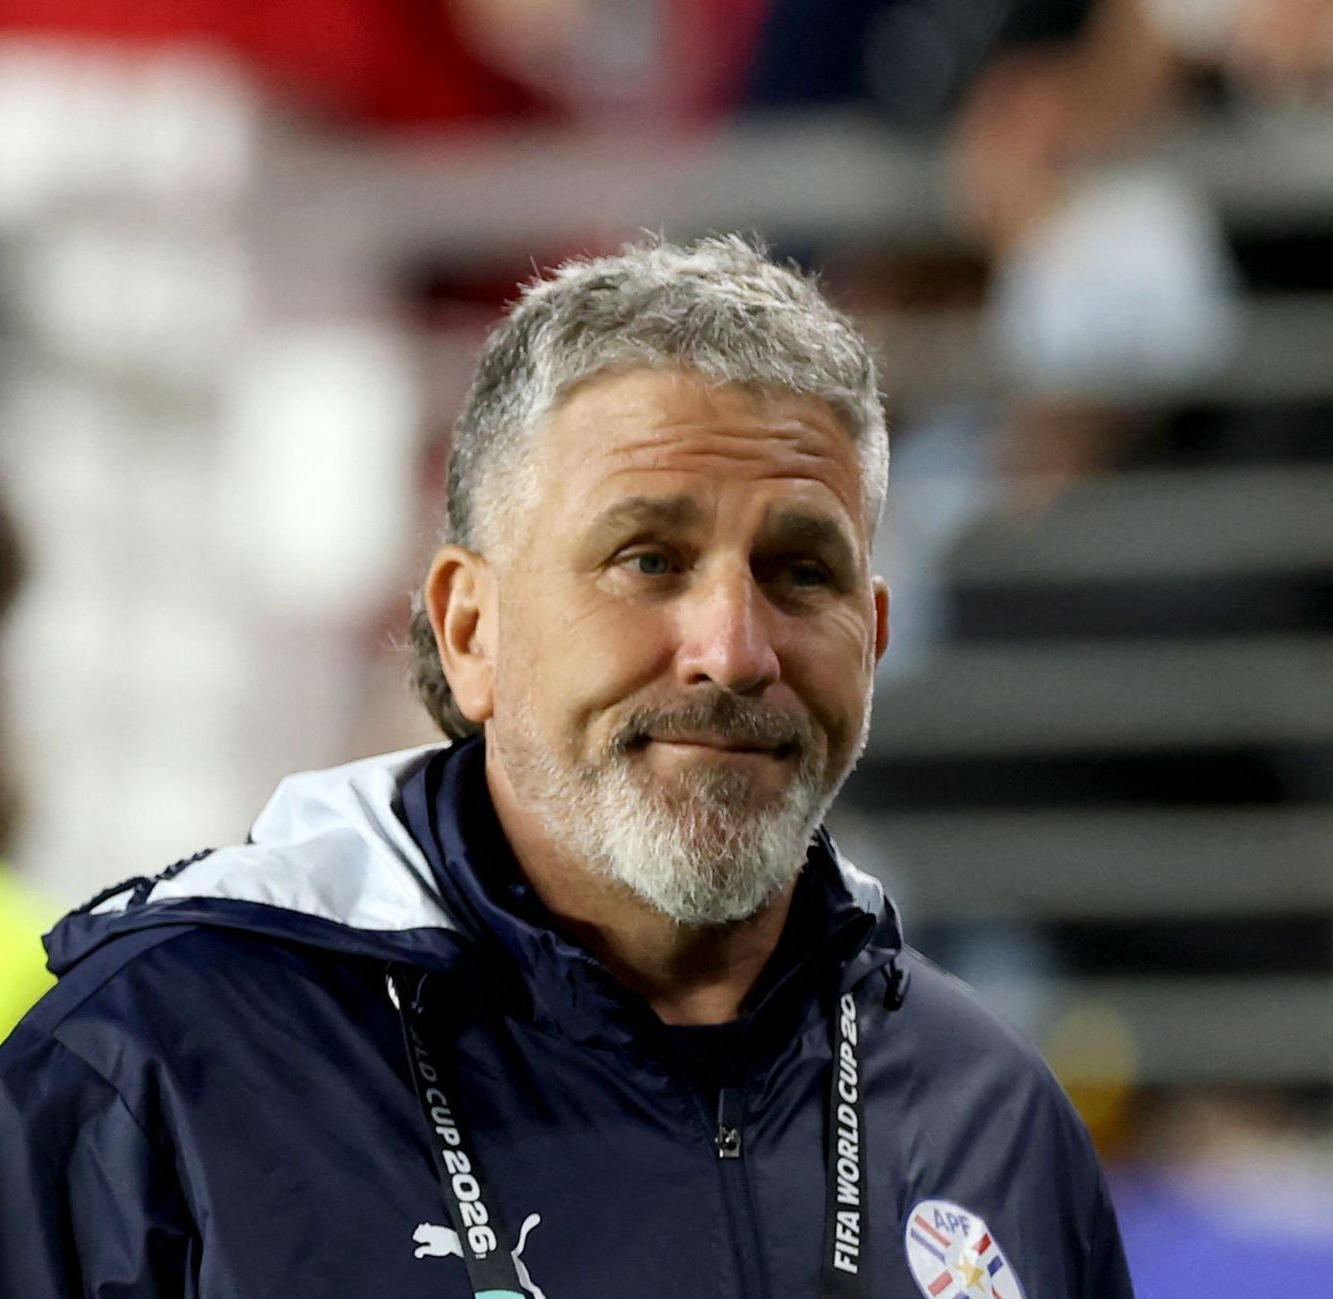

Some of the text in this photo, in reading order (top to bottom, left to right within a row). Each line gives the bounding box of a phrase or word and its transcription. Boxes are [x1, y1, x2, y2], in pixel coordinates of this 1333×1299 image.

[425, 1086, 461, 1147] CUP
[834, 992, 860, 1274] FIFA WORLD CUP 20
[441, 1149, 497, 1255] 2026
[933, 1207, 971, 1237] APF
